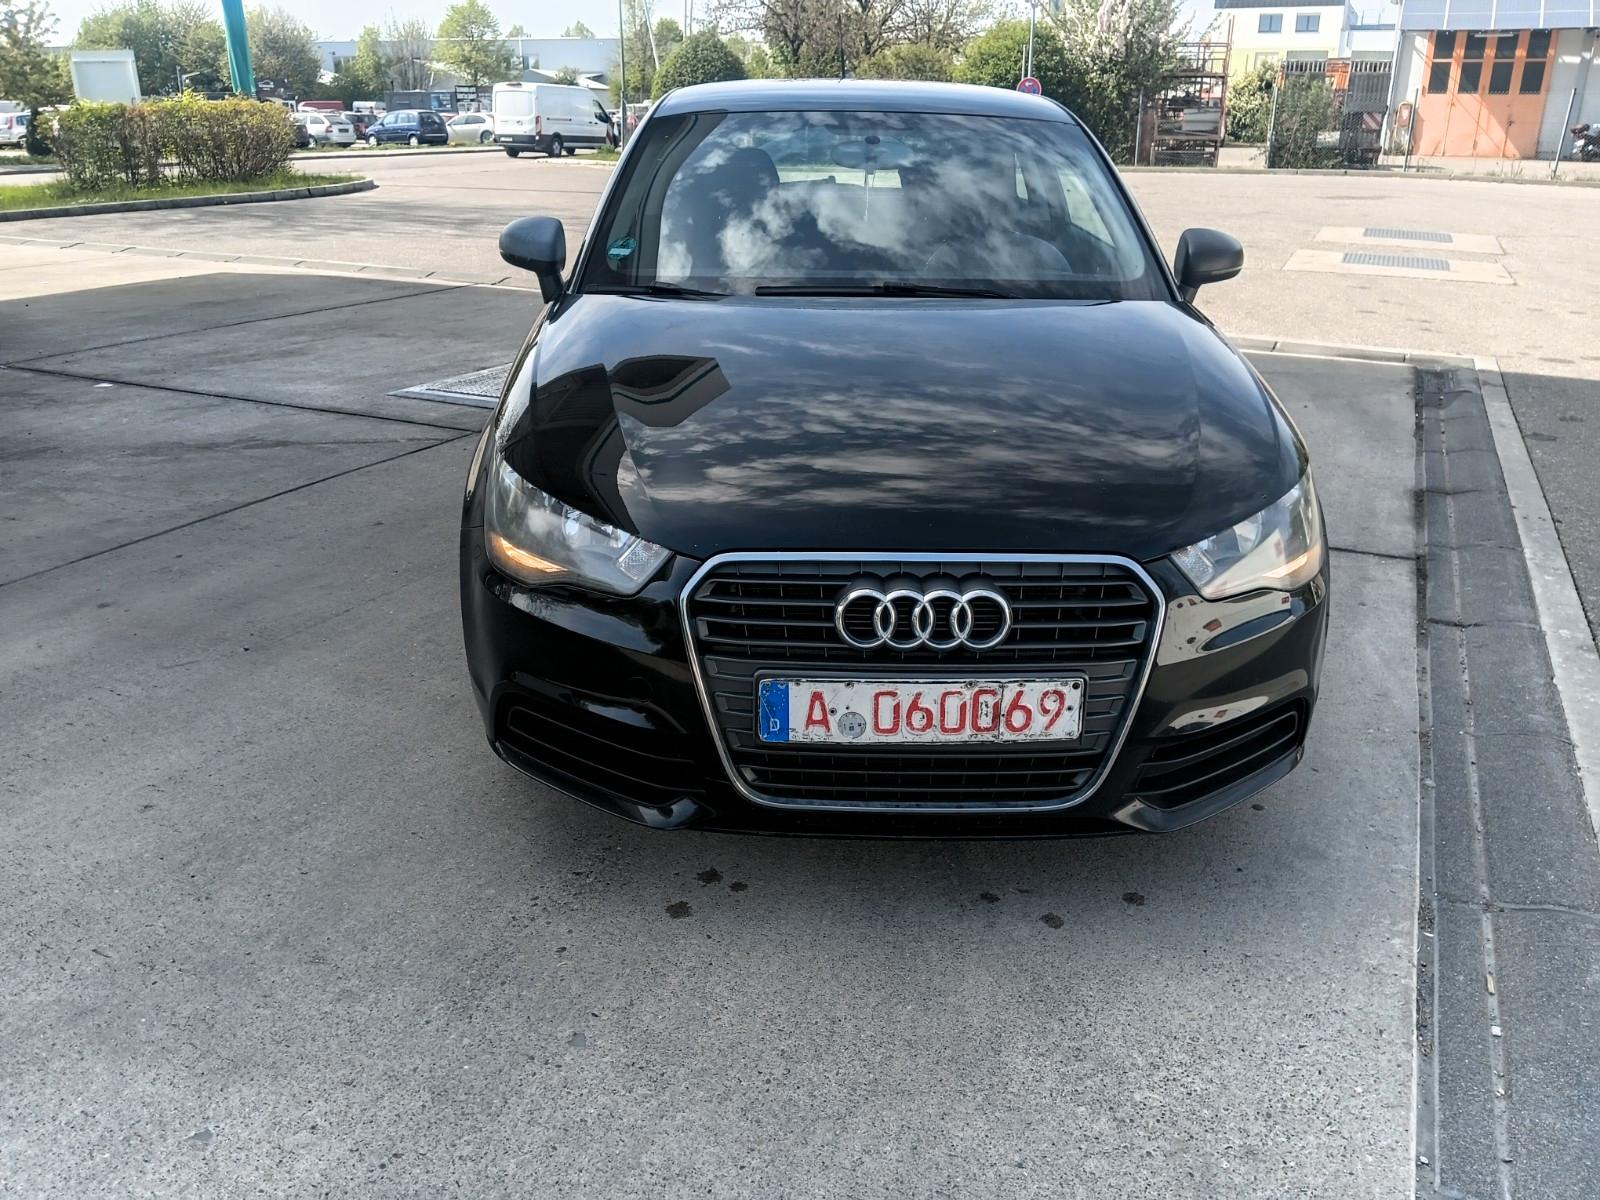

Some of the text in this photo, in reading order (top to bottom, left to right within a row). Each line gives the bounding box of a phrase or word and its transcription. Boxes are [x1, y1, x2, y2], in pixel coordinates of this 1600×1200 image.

[770, 718, 780, 732] D
[805, 689, 1067, 735] A 060069
